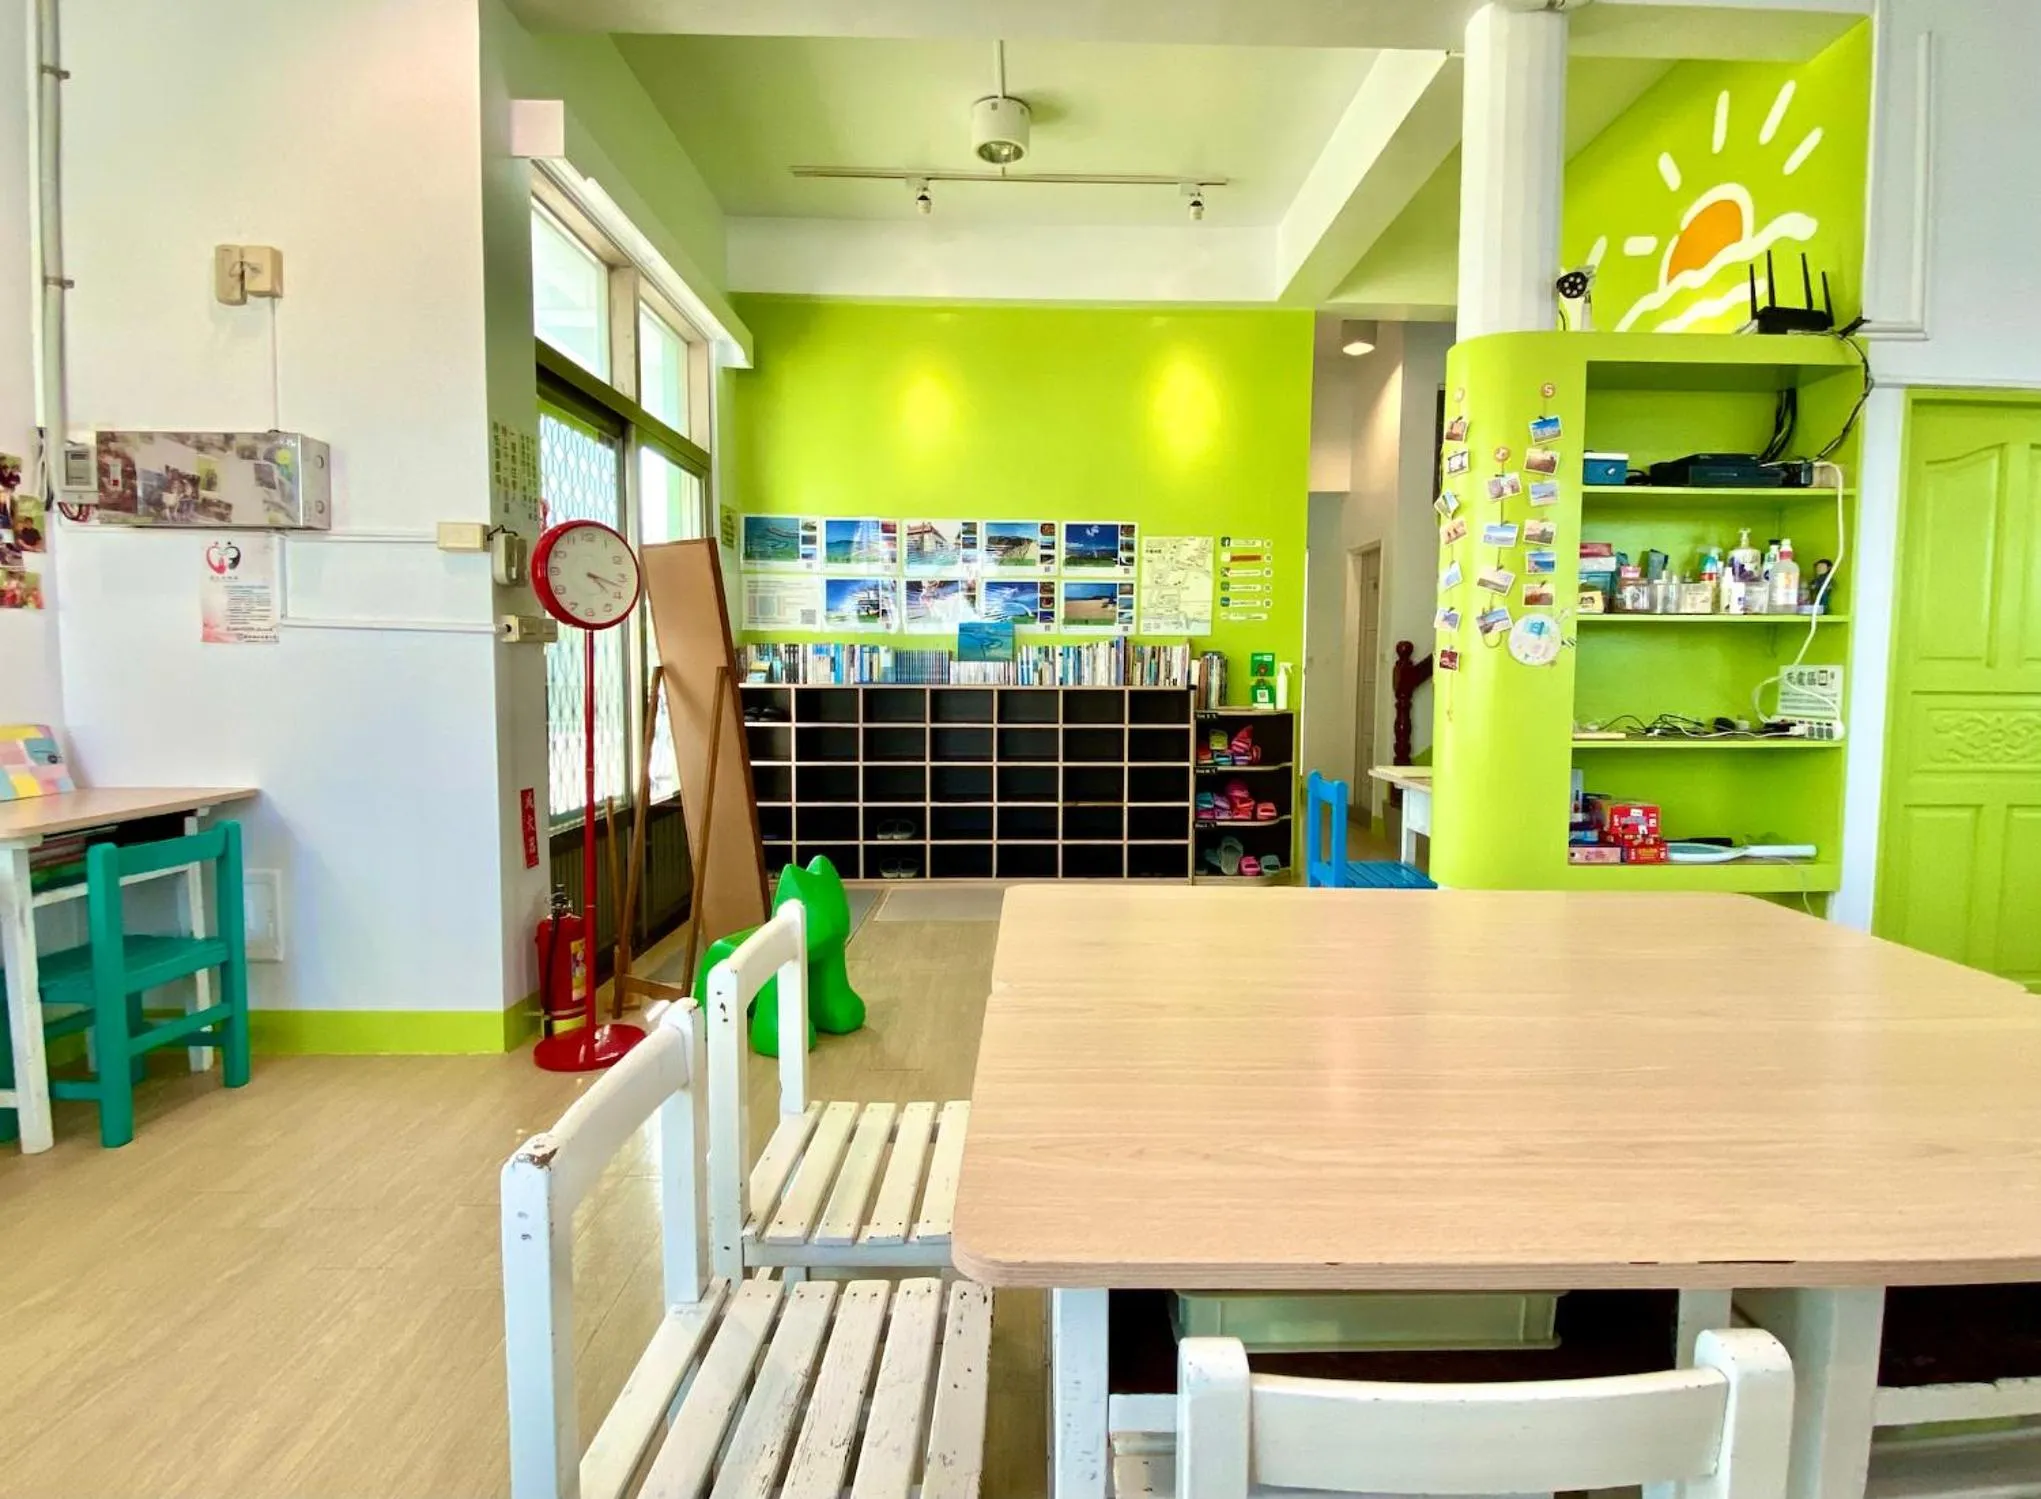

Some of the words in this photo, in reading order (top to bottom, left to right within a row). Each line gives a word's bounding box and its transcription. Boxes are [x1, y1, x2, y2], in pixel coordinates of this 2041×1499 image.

[567, 535, 576, 545] 11
[581, 532, 595, 542] 12
[612, 555, 623, 565] 2
[569, 602, 579, 611] 7
